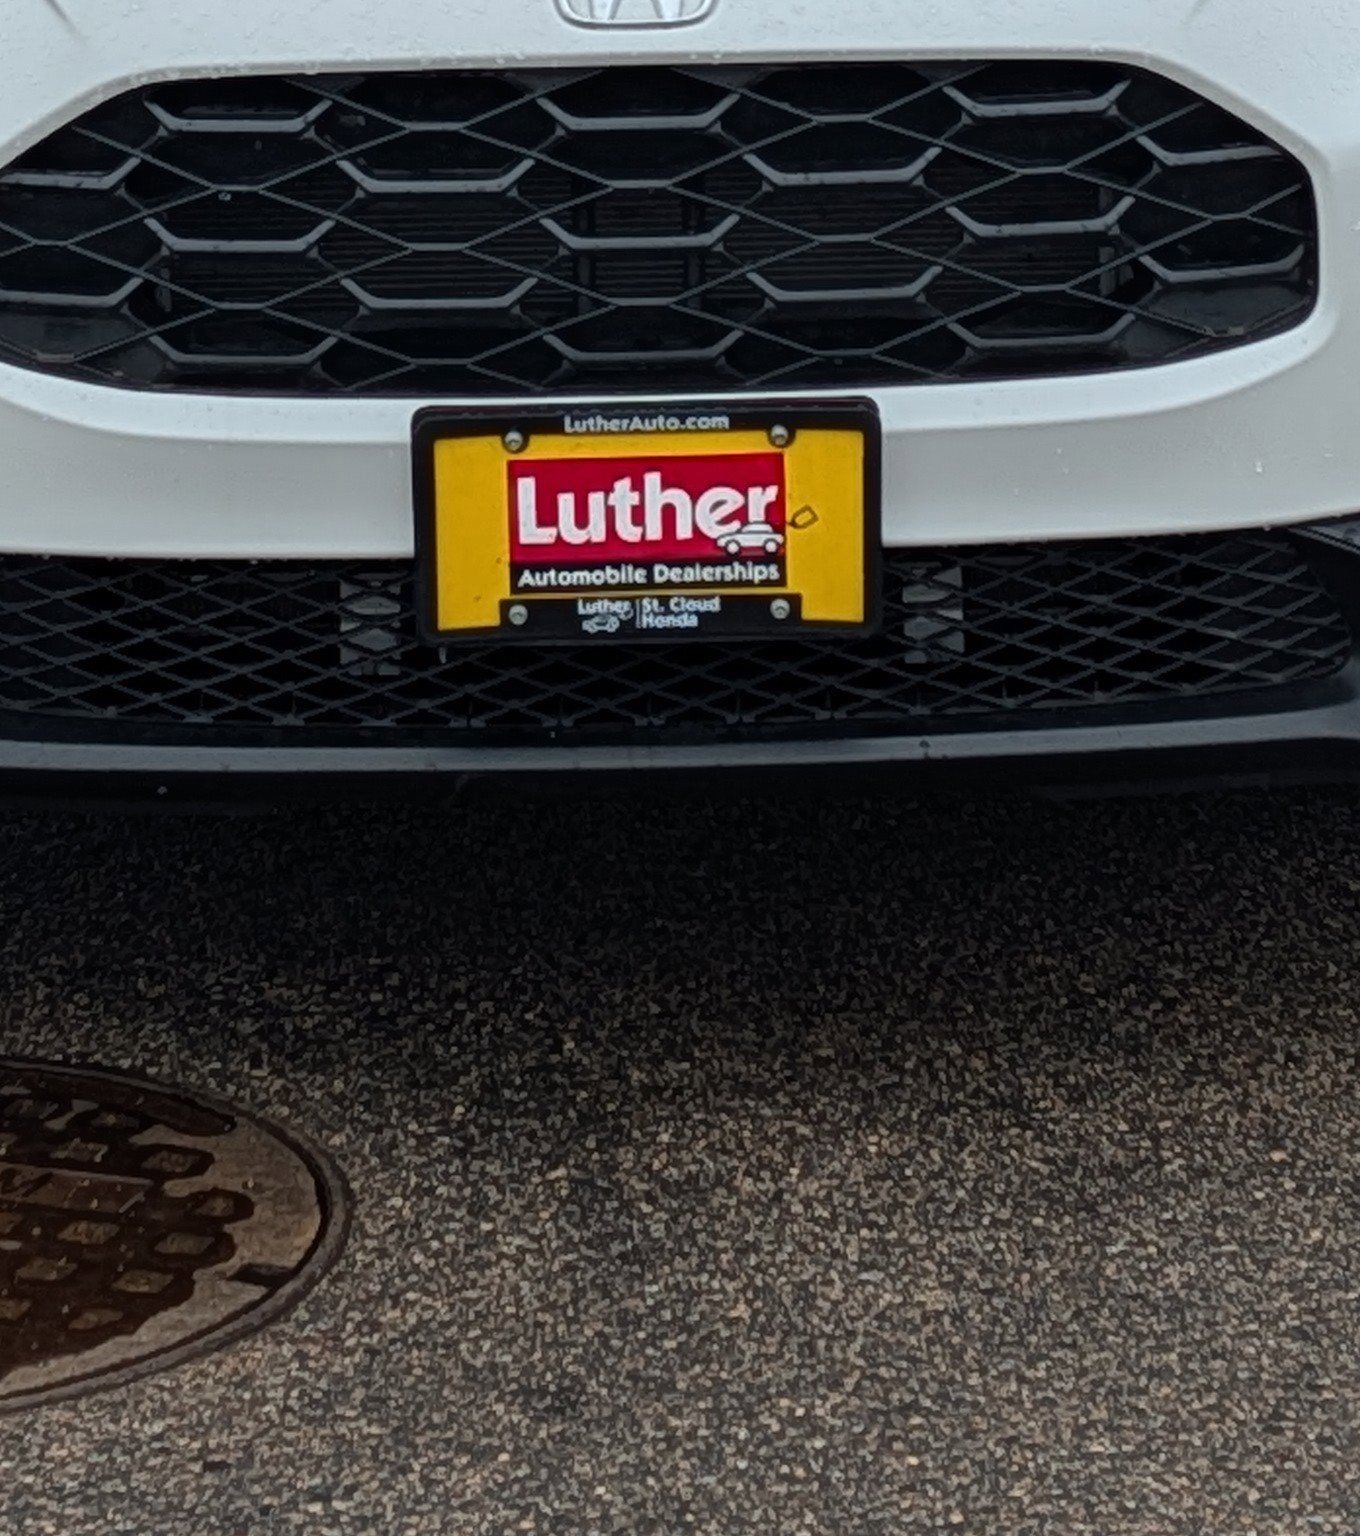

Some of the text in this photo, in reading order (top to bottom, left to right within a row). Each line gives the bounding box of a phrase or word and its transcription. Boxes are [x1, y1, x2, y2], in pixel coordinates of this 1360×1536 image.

[563, 414, 730, 435] LutherAuto.com
[516, 471, 779, 546] Luther
[518, 561, 780, 588] Automobile Dealerships
[577, 596, 721, 615] Luther St. Cloud
[641, 613, 699, 629] Honda
